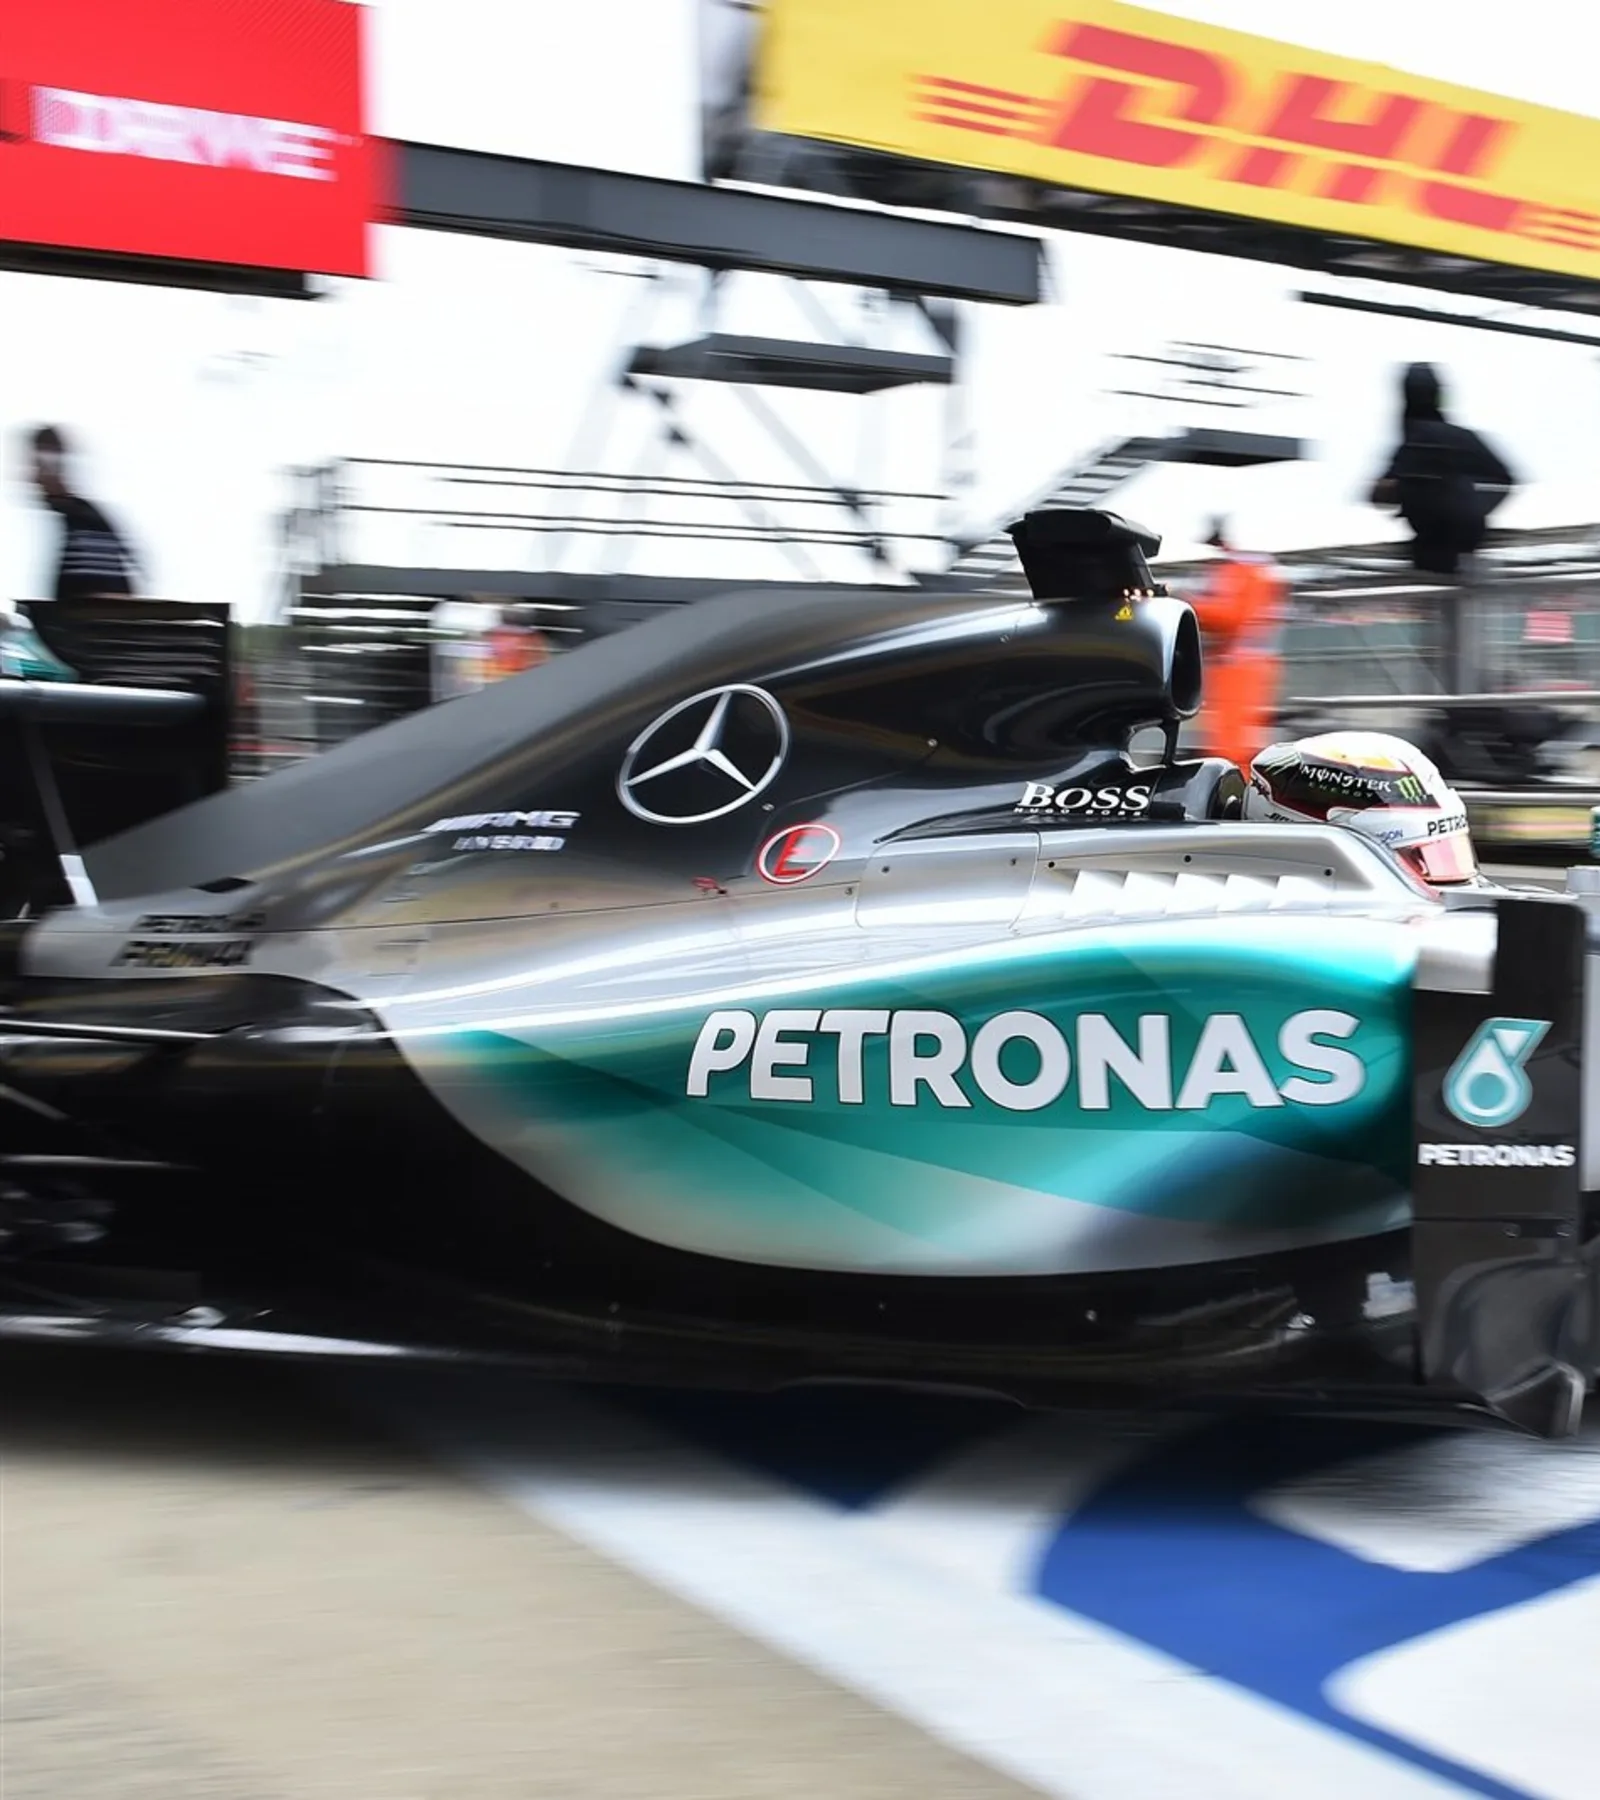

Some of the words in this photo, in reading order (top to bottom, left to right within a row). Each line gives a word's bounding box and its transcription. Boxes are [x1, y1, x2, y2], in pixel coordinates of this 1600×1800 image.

[1034, 18, 1522, 234] DHL
[1301, 765, 1392, 793] MONSTER
[1016, 781, 1150, 811] BOSS
[686, 1009, 1367, 1111] PETRONAS
[1417, 1143, 1576, 1167] PETRONAS
